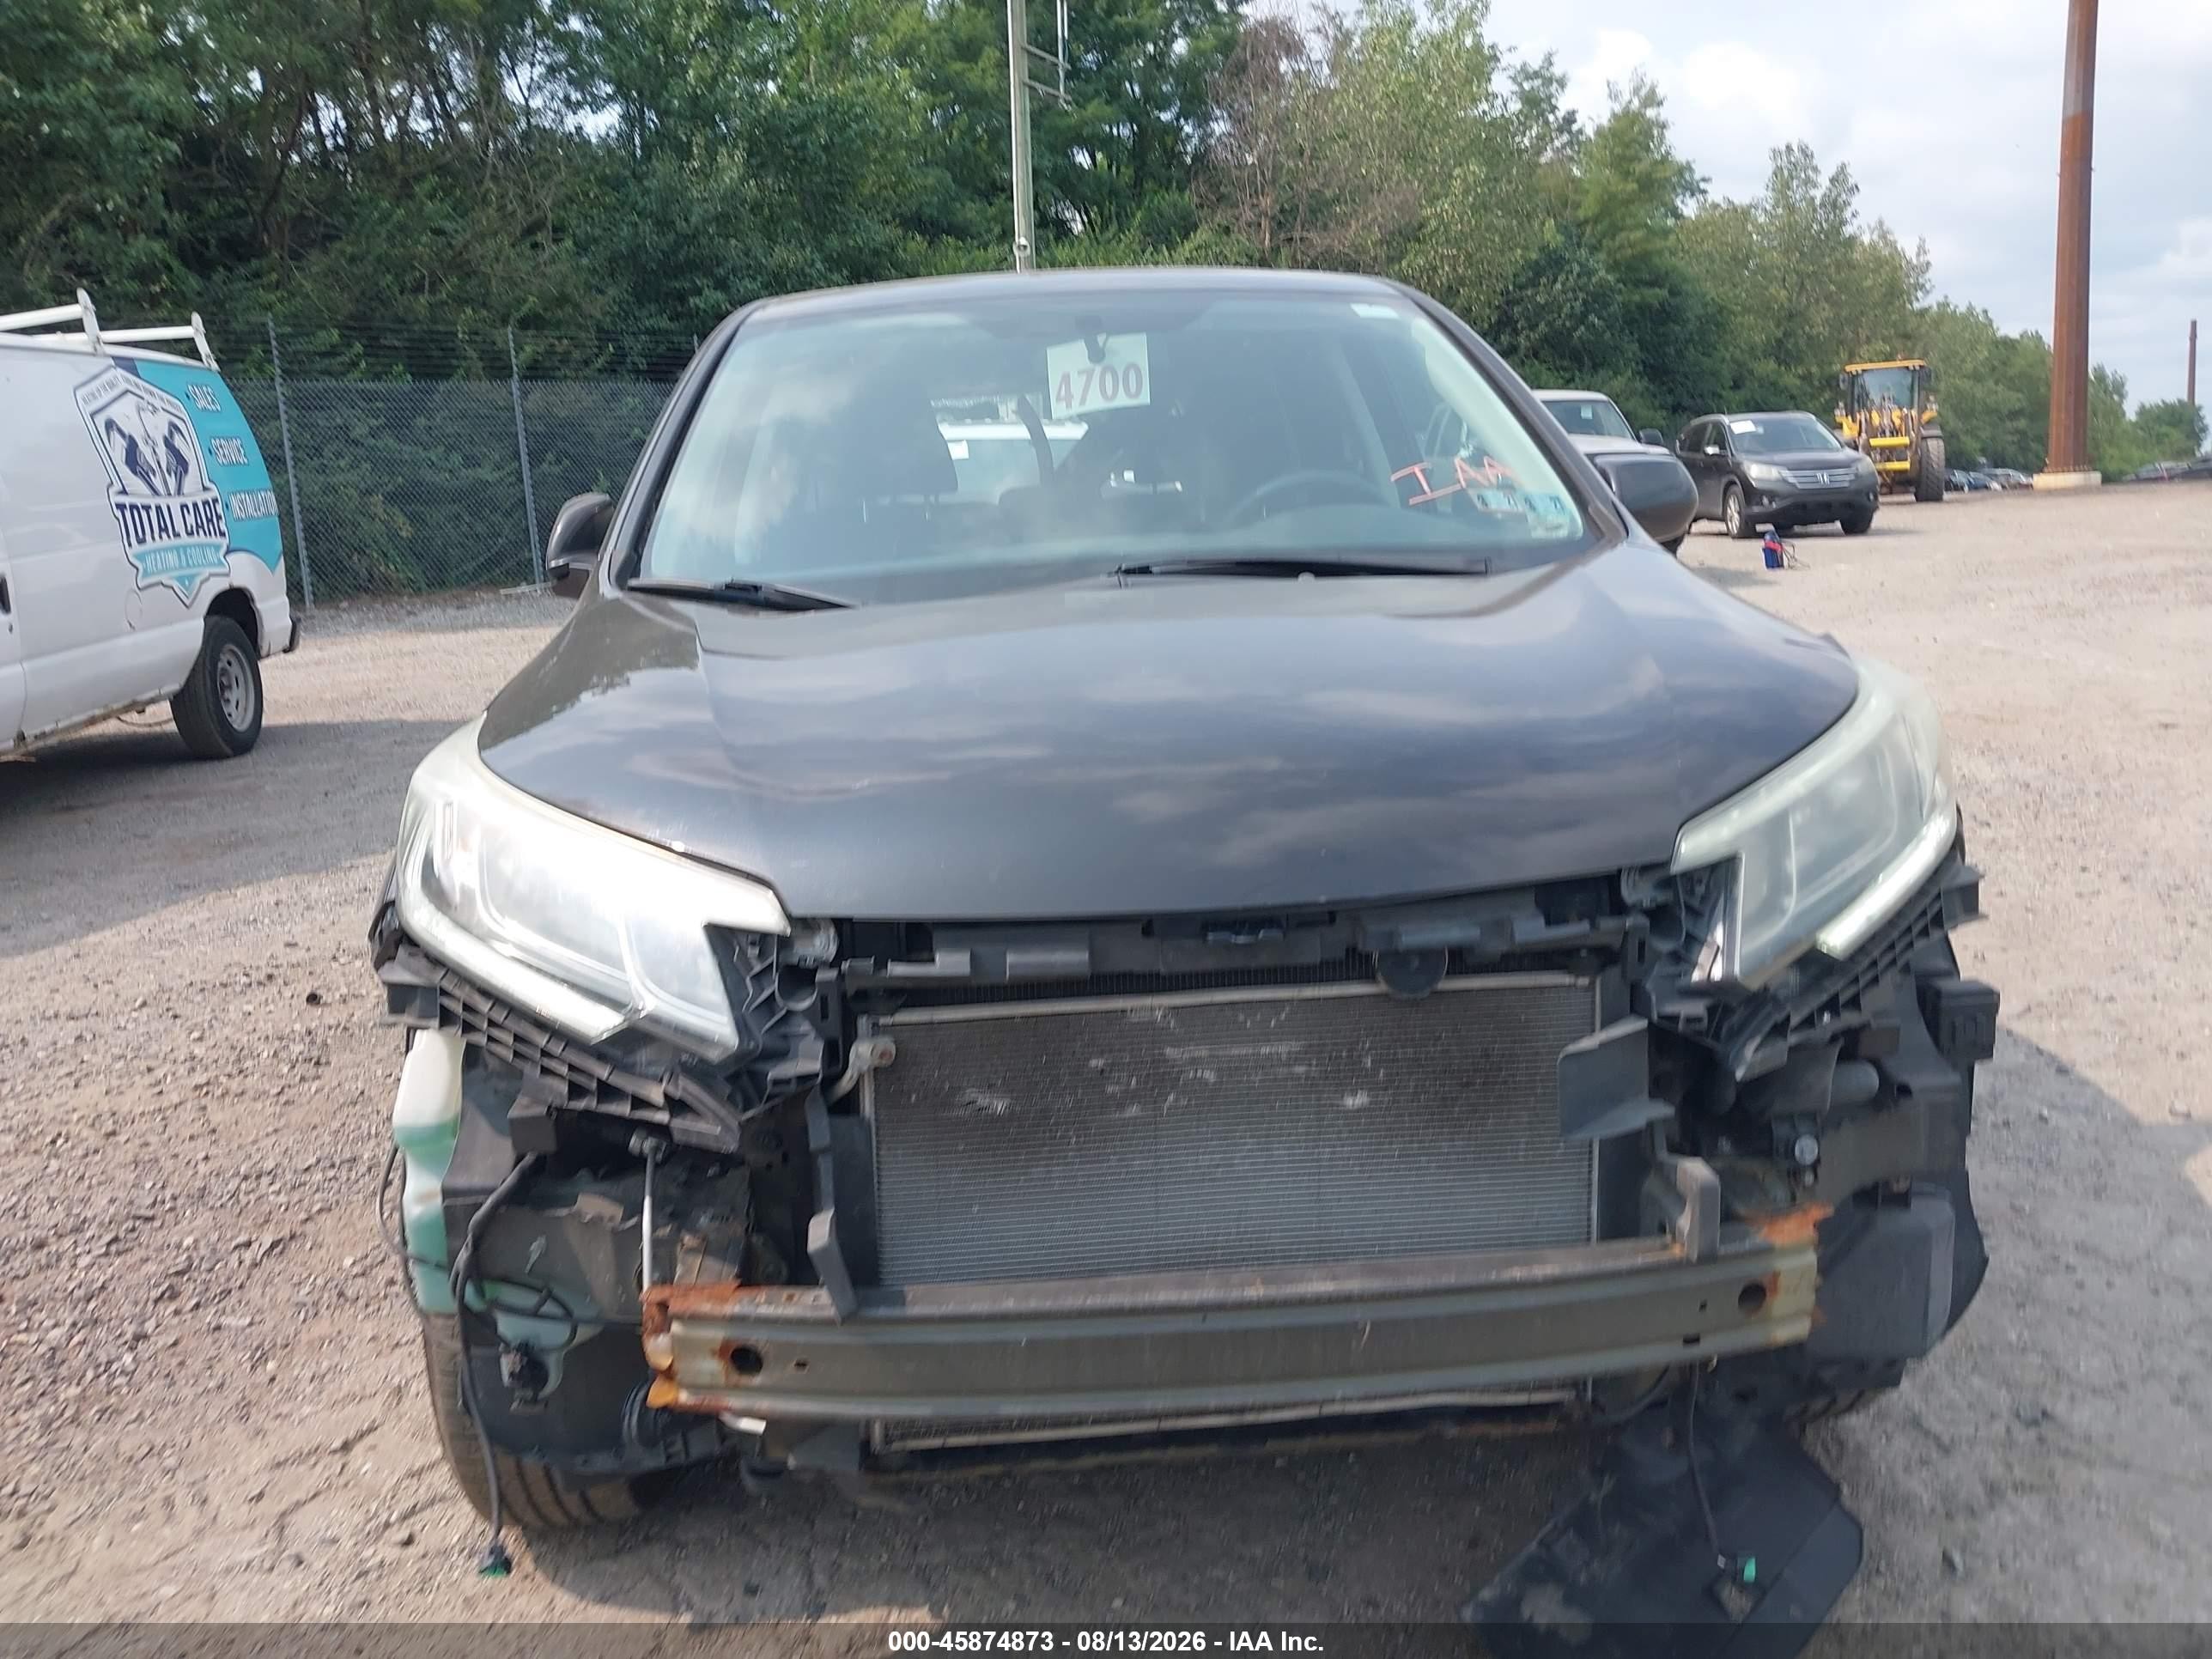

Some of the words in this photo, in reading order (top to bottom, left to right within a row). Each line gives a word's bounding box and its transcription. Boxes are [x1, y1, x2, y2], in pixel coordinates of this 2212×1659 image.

[187, 385, 221, 411] SALES
[1055, 362, 1144, 410] 4700
[211, 438, 248, 465] SERVICE
[115, 502, 179, 547] TOTAL
[180, 499, 226, 537] CARE
[145, 550, 179, 574] HEATING
[187, 545, 218, 567] COOLING
